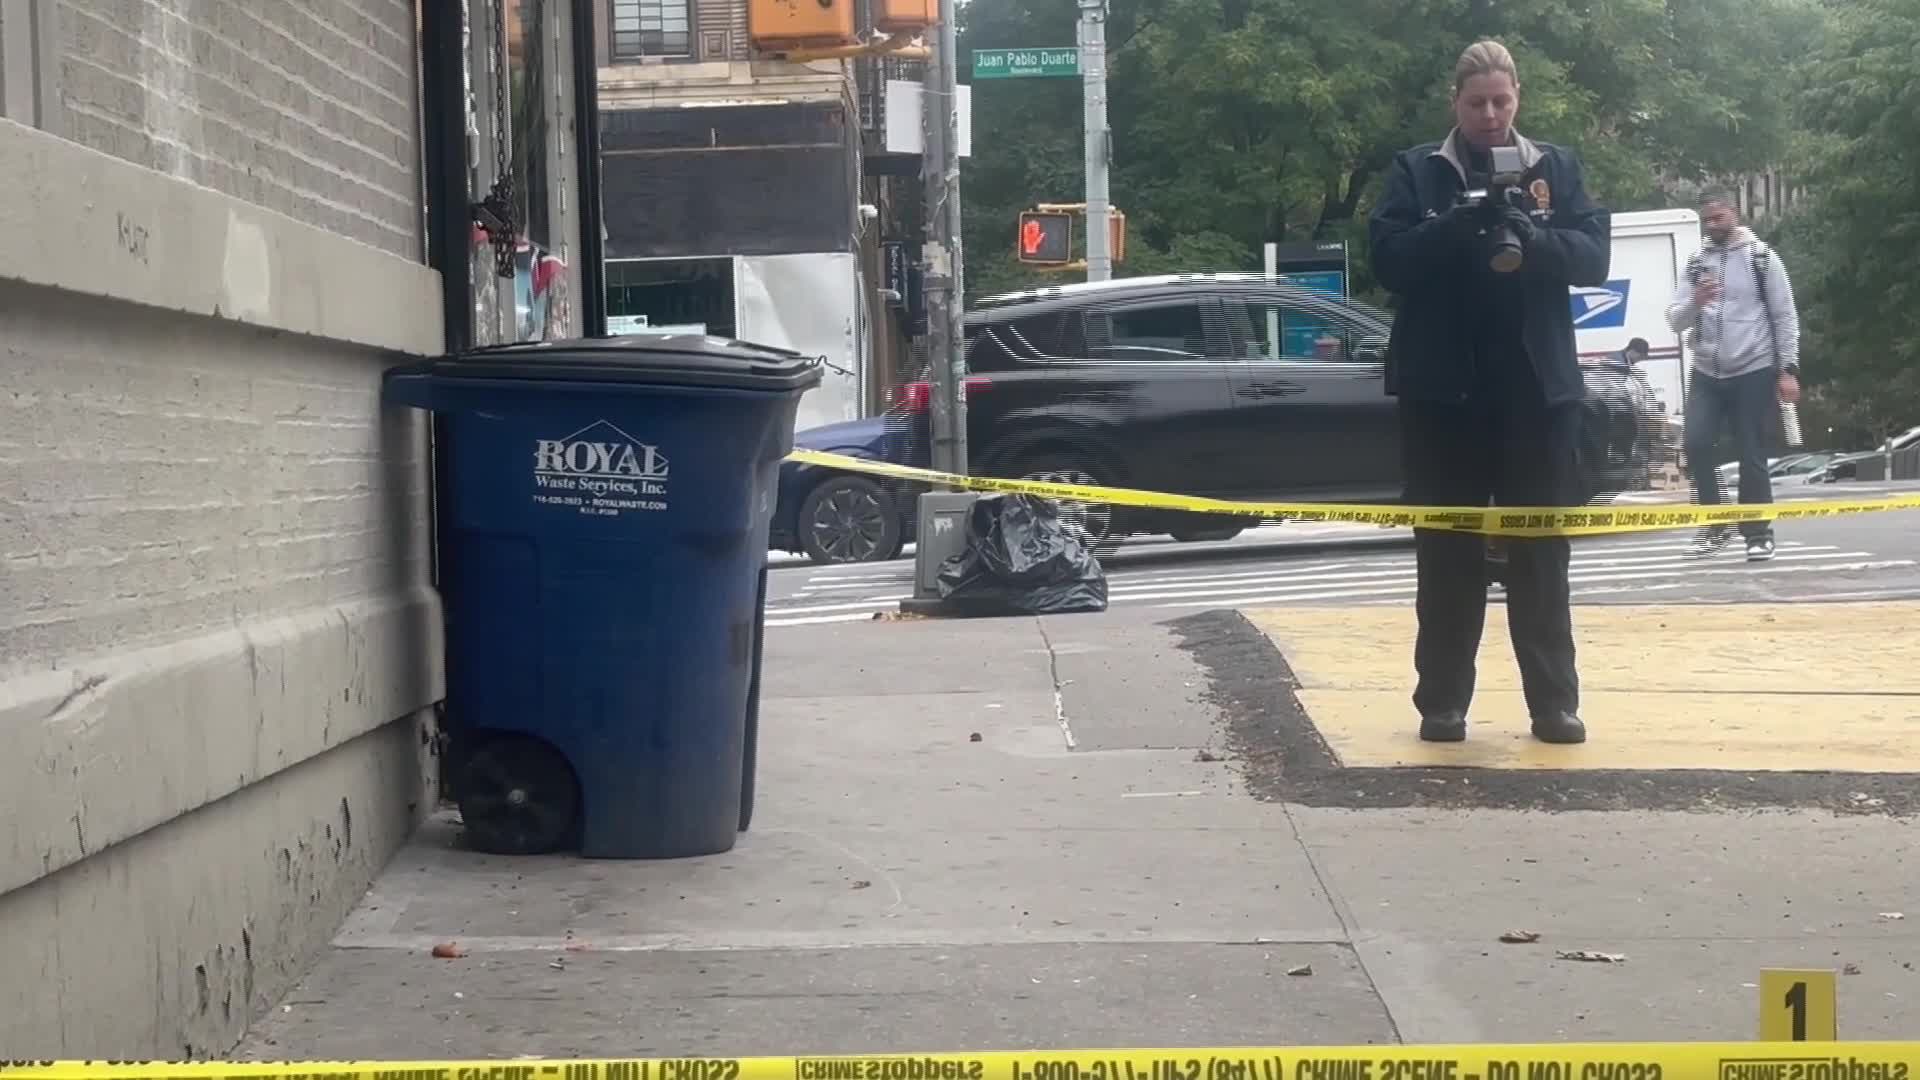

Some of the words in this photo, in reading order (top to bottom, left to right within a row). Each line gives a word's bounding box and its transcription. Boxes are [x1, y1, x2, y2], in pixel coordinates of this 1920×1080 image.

[977, 54, 1003, 67] Juan
[1007, 52, 1037, 66] Pablo
[1041, 51, 1076, 65] Duarte
[534, 439, 669, 476] ROYAL
[535, 475, 576, 490] Waste
[578, 477, 638, 495] Services,
[641, 481, 667, 495] Inc.
[592, 498, 668, 510] ROYALWASTE.COM
[1785, 981, 1807, 1041] 1
